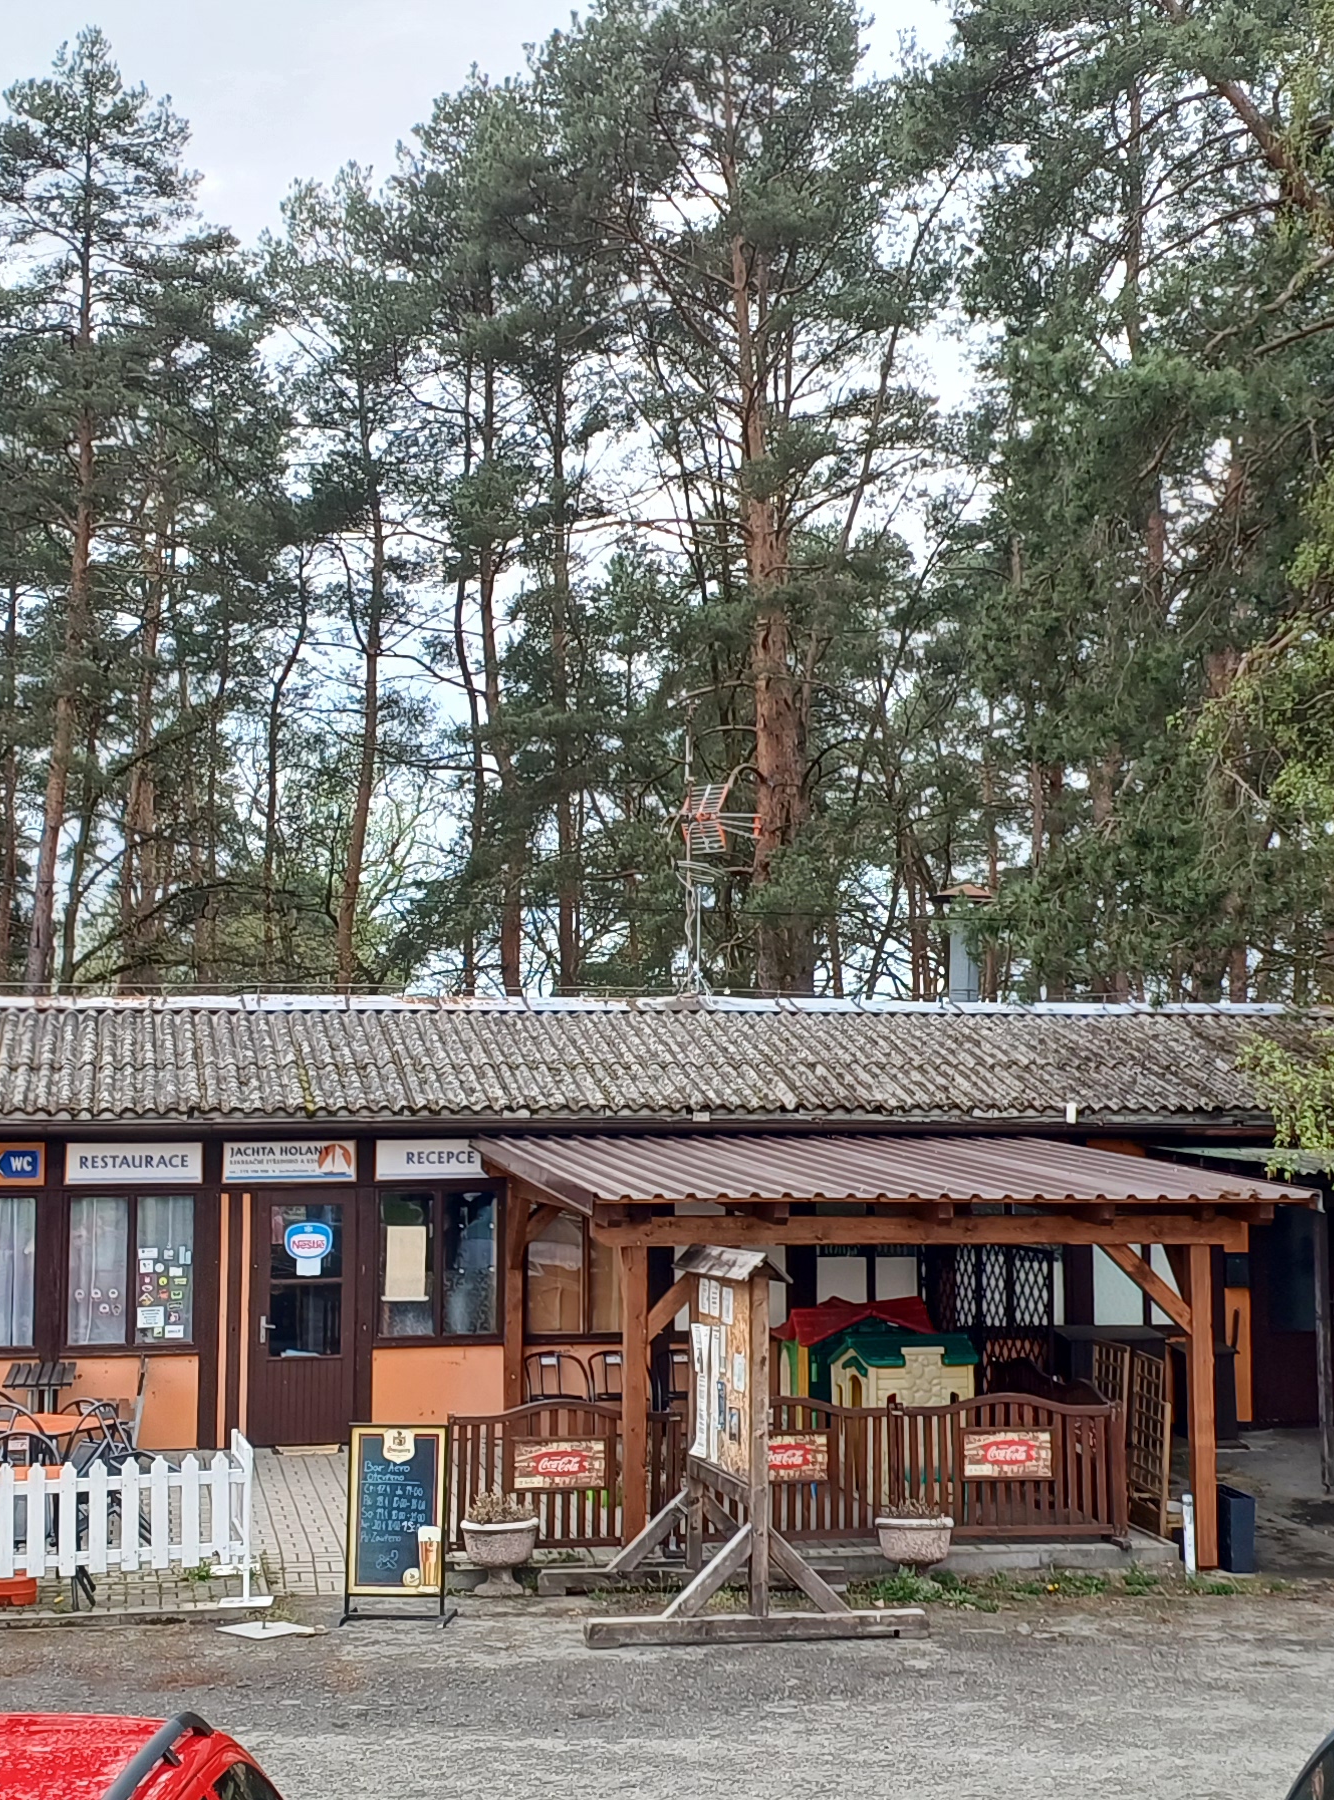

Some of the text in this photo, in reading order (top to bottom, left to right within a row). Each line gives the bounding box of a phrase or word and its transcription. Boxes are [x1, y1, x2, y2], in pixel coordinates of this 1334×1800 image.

[230, 1146, 276, 1158] JACHTA
[406, 1151, 475, 1165] RECEPCE
[10, 1156, 33, 1172] WC
[79, 1154, 189, 1169] RESTAURACE
[538, 1456, 582, 1473] Coca-Cola
